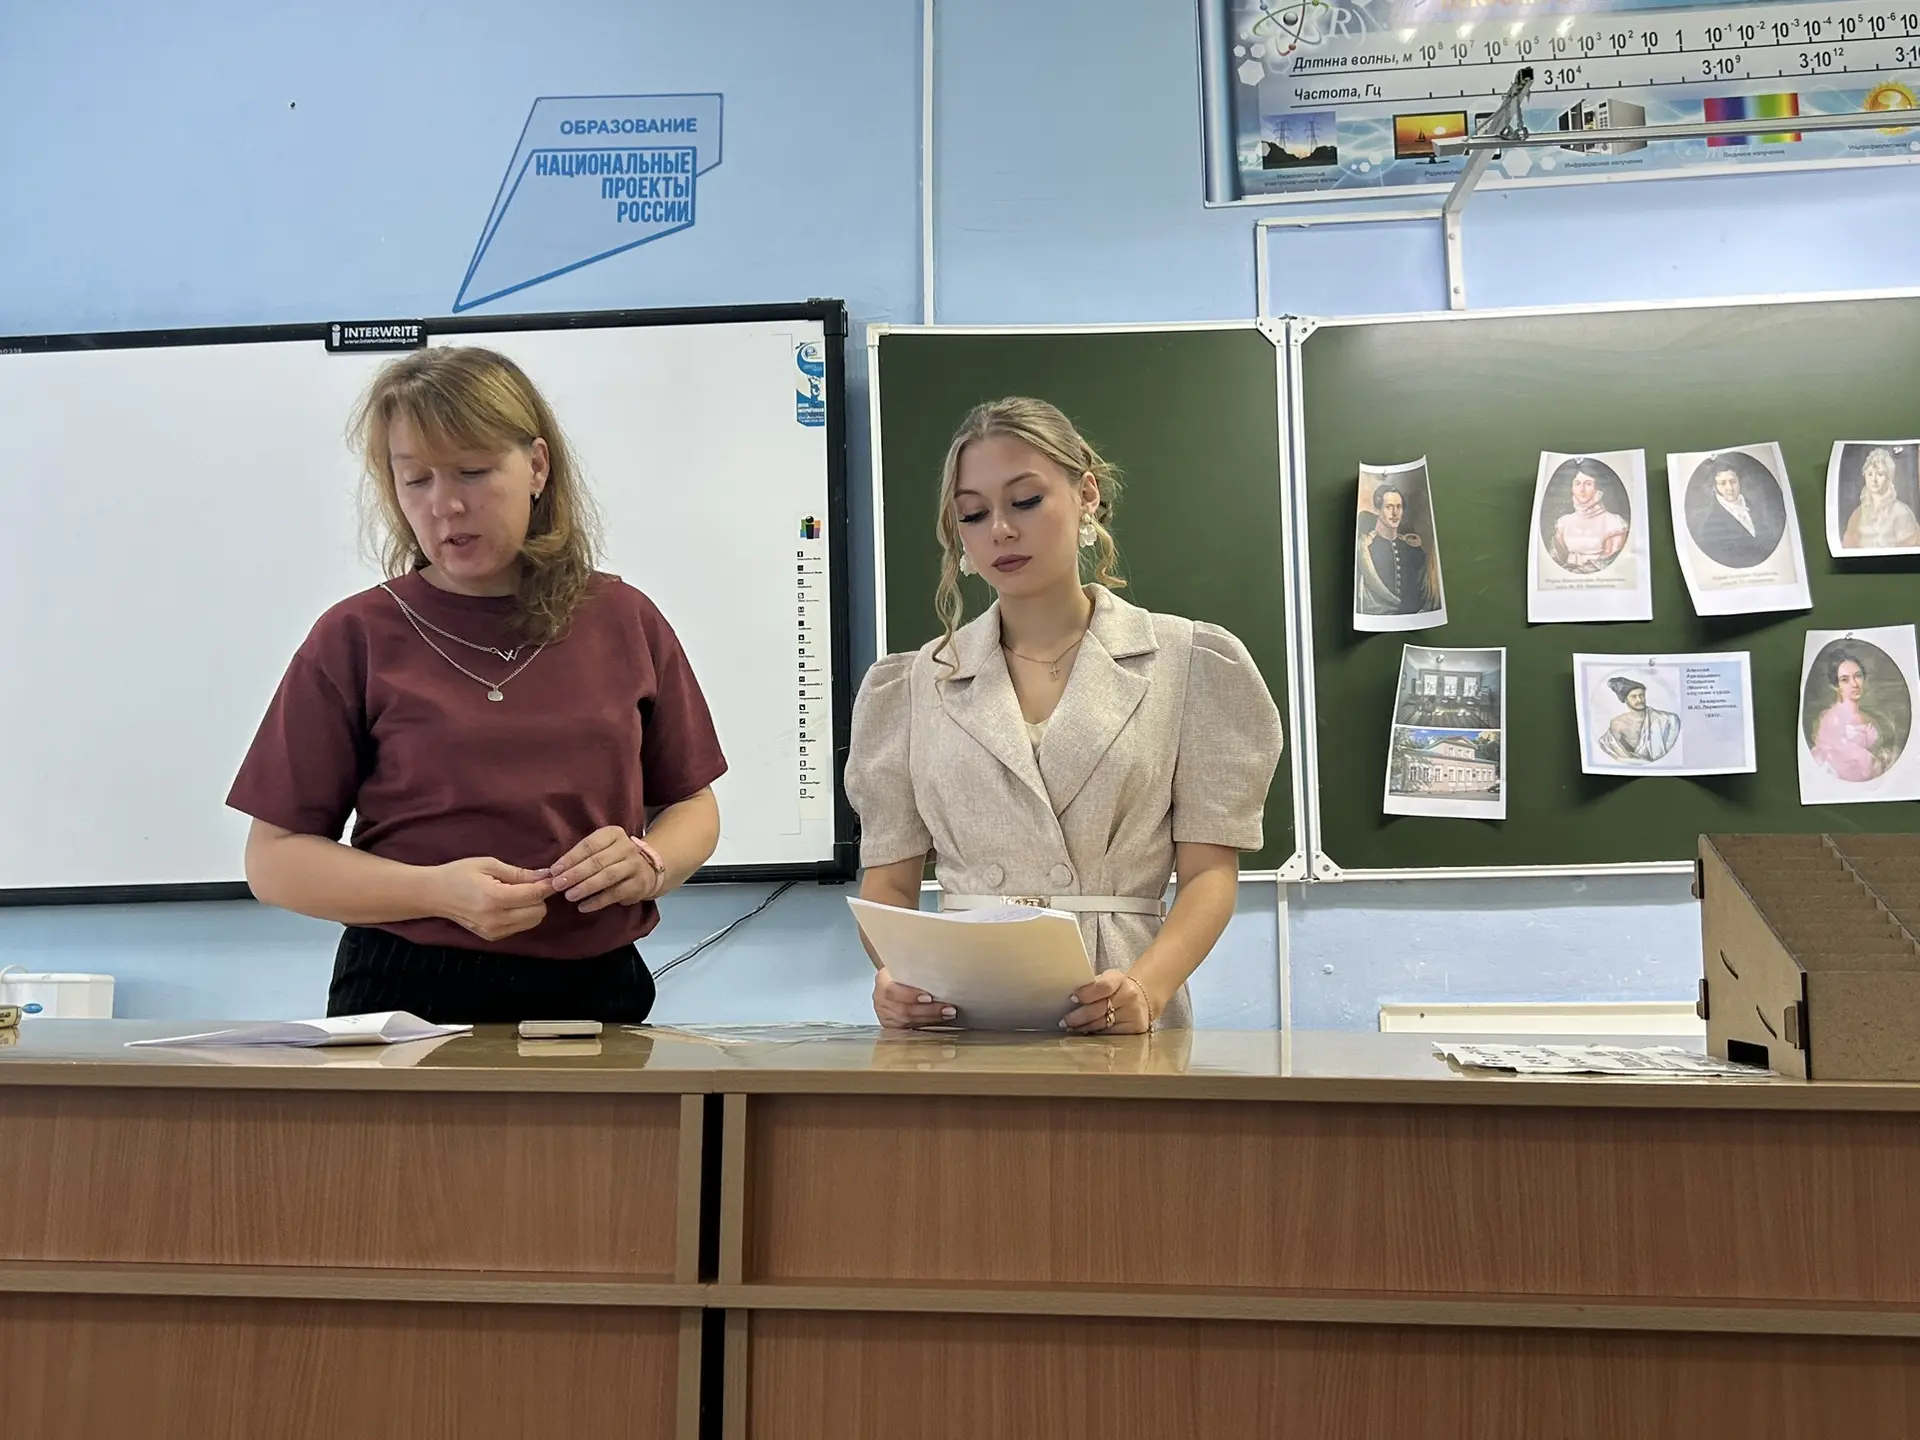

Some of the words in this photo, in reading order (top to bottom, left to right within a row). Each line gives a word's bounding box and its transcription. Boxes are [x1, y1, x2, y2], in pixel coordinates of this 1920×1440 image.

[1640, 31, 1658, 47] 10
[1675, 30, 1683, 45] 1
[1351, 54, 1399, 66] волны,
[1402, 53, 1412, 63] м
[1294, 86, 1361, 100] Частота,
[1365, 84, 1382, 98] Гц
[560, 117, 697, 135] ОБРАЗОВАНИЕ
[536, 152, 691, 177] НАЦИОНАЛЬНЫЕ
[601, 176, 690, 199] ПРОЕКТЫ
[617, 200, 690, 223] РОССИИ
[344, 325, 419, 338] INTERWRITE
